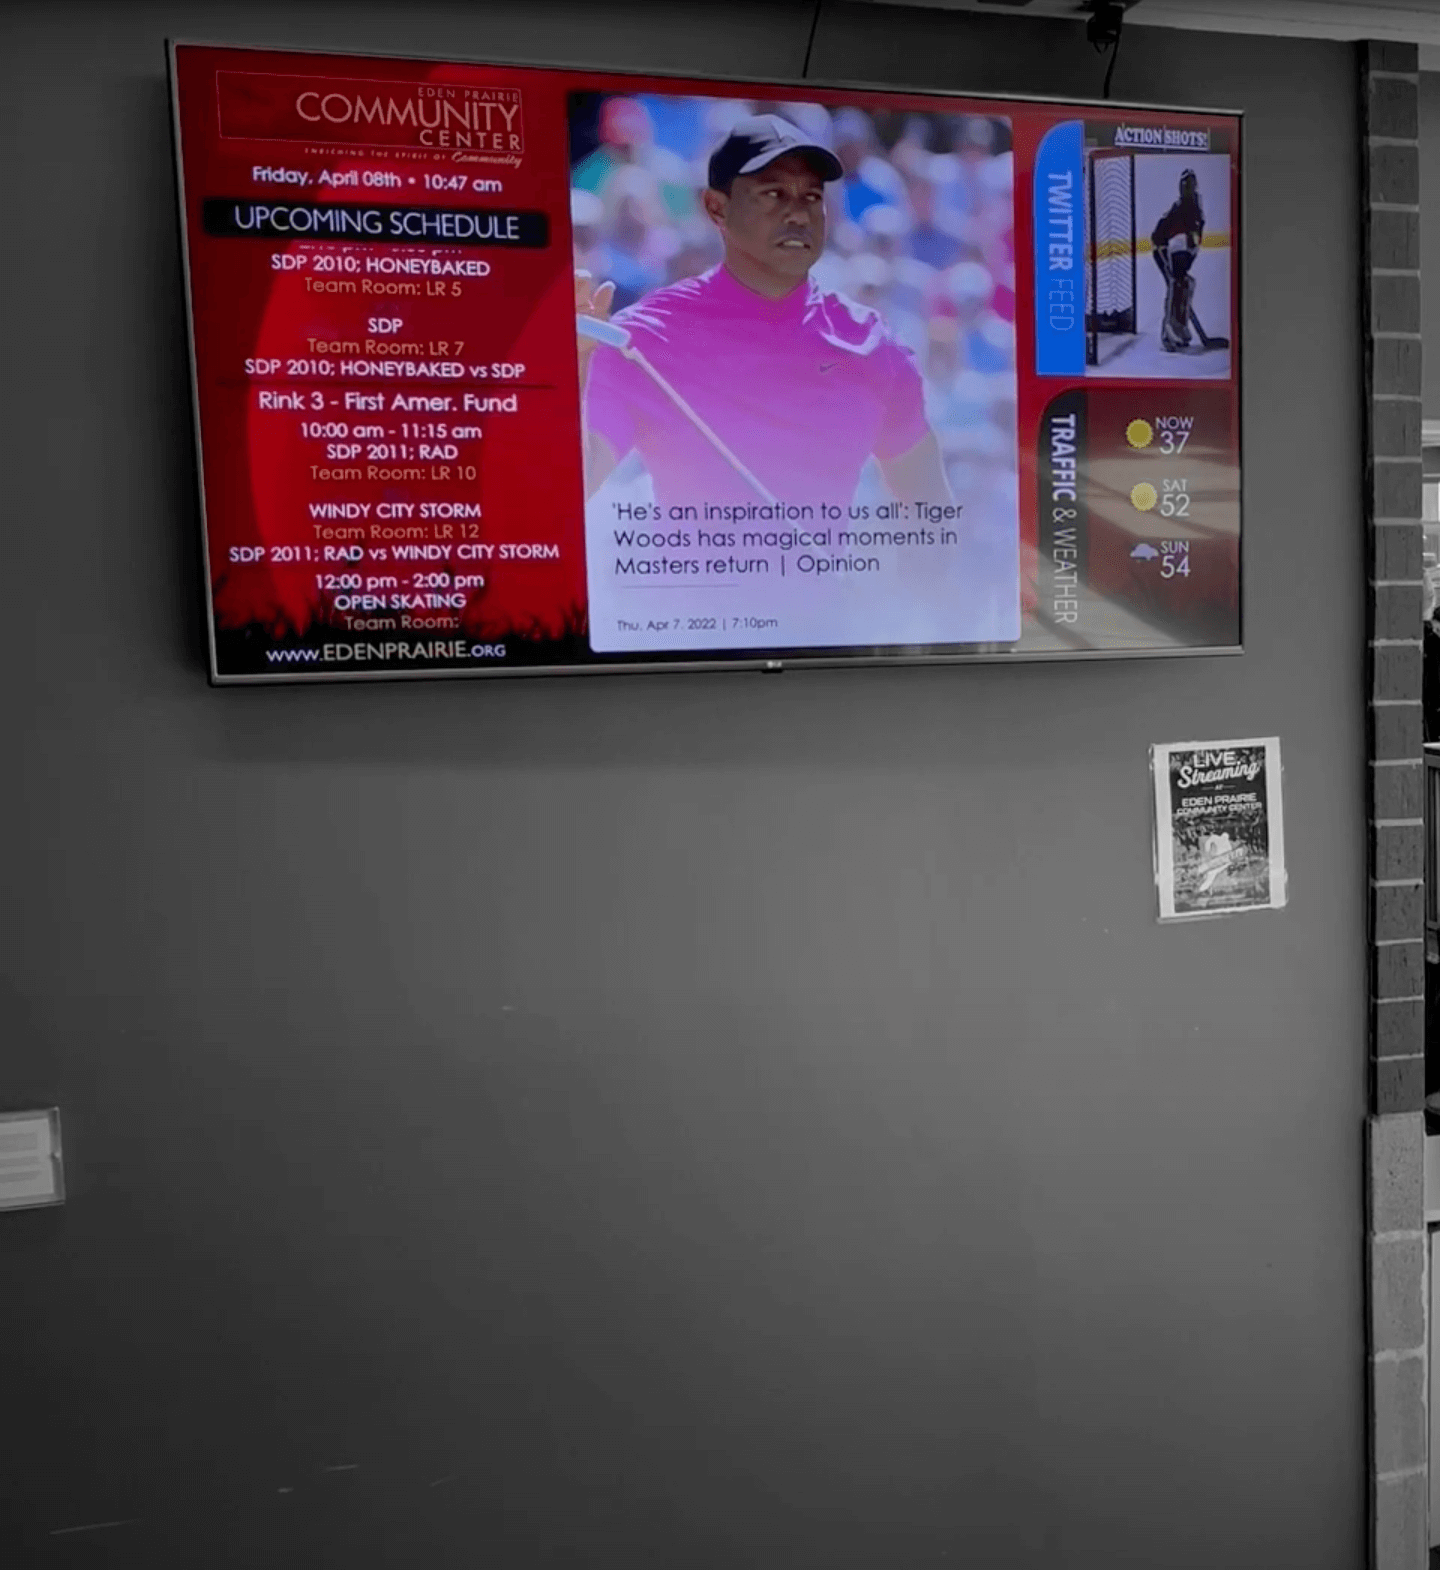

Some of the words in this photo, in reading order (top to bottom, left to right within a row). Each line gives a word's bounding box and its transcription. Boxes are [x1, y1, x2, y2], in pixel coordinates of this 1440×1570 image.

[418, 87, 456, 99] EDEN
[465, 90, 519, 103] PRAIRIE
[297, 92, 519, 132] COMMUNITY
[419, 130, 521, 150] CENTER
[1114, 126, 1162, 143] ACTION
[252, 166, 313, 187] Friday,
[318, 170, 359, 189] April
[362, 171, 401, 188] 08th
[424, 174, 467, 191] 10:47
[473, 179, 503, 193] am
[235, 206, 382, 234] UPCOMING
[389, 211, 520, 240] SCHEDULE
[1047, 171, 1074, 271] TWITTER
[271, 254, 307, 270] SDP
[313, 255, 361, 273] 2010;
[366, 257, 490, 276] HONEYBAKED
[305, 277, 357, 293] Team
[362, 279, 422, 295] Room:
[427, 282, 446, 296] LR
[451, 282, 462, 296] 5
[1049, 278, 1075, 331] FEED
[368, 317, 404, 334] SDP
[307, 338, 360, 354] Team
[365, 339, 425, 356] Room:
[429, 341, 451, 356] LR
[454, 341, 464, 356] 7
[244, 358, 281, 375] SDP
[286, 360, 335, 377] 2010;
[340, 360, 465, 378] HONEYBAKED
[469, 364, 488, 378] vs
[491, 362, 526, 379] SDP
[258, 391, 305, 410] Rink
[310, 391, 324, 411] 3
[344, 392, 384, 411] First
[390, 393, 457, 412] Amer.
[463, 393, 518, 412] Fund
[301, 422, 348, 439] 10:00
[353, 425, 384, 439] am
[401, 422, 447, 440] 11:15
[451, 425, 482, 440] am
[1156, 416, 1194, 429] NOW
[1160, 431, 1190, 454] 37
[327, 444, 361, 460] SDP
[366, 444, 414, 462] 2011;
[419, 444, 458, 460] RAD
[1051, 413, 1076, 502] TRAFFIC
[310, 465, 362, 481] Team
[367, 465, 427, 481] Room:
[431, 466, 451, 480] LR
[457, 466, 477, 480] 10
[1162, 479, 1188, 492] SAT
[309, 503, 371, 519] WINDY
[376, 503, 415, 518] CITY
[419, 503, 482, 518] STORM
[612, 502, 662, 521] 'He's
[668, 505, 698, 521] an
[704, 501, 815, 524] inspiration
[821, 503, 842, 519] to
[848, 504, 870, 519] us
[914, 502, 963, 523] Tiger
[1160, 494, 1190, 517] 52
[1053, 507, 1077, 523] &
[313, 524, 365, 539] Team
[370, 524, 429, 539] Room:
[434, 524, 453, 538] LR
[460, 524, 480, 538] 12
[613, 528, 691, 548] Woods
[698, 528, 736, 547] has
[742, 528, 832, 551] magical
[837, 528, 935, 546] moments
[941, 527, 958, 545] in
[229, 547, 265, 562] SDP
[324, 545, 364, 561] RAD
[369, 548, 388, 561] vs
[391, 545, 452, 560] WINDY
[457, 544, 495, 559] CITY
[499, 544, 560, 559] STORM
[1160, 541, 1189, 554] SUN
[615, 556, 700, 575] Masters
[705, 556, 769, 574] return
[797, 555, 880, 575] Opinion
[1160, 555, 1191, 578] 54
[315, 574, 362, 589] 12:00
[366, 576, 398, 591] pm
[413, 573, 449, 589] 2:00
[454, 575, 485, 590] pm
[1054, 528, 1077, 623] WEATHER
[335, 594, 387, 610] OPEN
[390, 593, 467, 609] SKATING
[344, 616, 396, 631] Team
[401, 614, 460, 630] Room:
[647, 620, 669, 632] Apr
[687, 618, 717, 630] 2022
[732, 617, 778, 630] 7:10pm
[1193, 751, 1236, 768] LIVE
[1177, 761, 1260, 788] Streaming
[1182, 796, 1213, 806] EDEN
[1215, 793, 1257, 804] PRAIRIE
